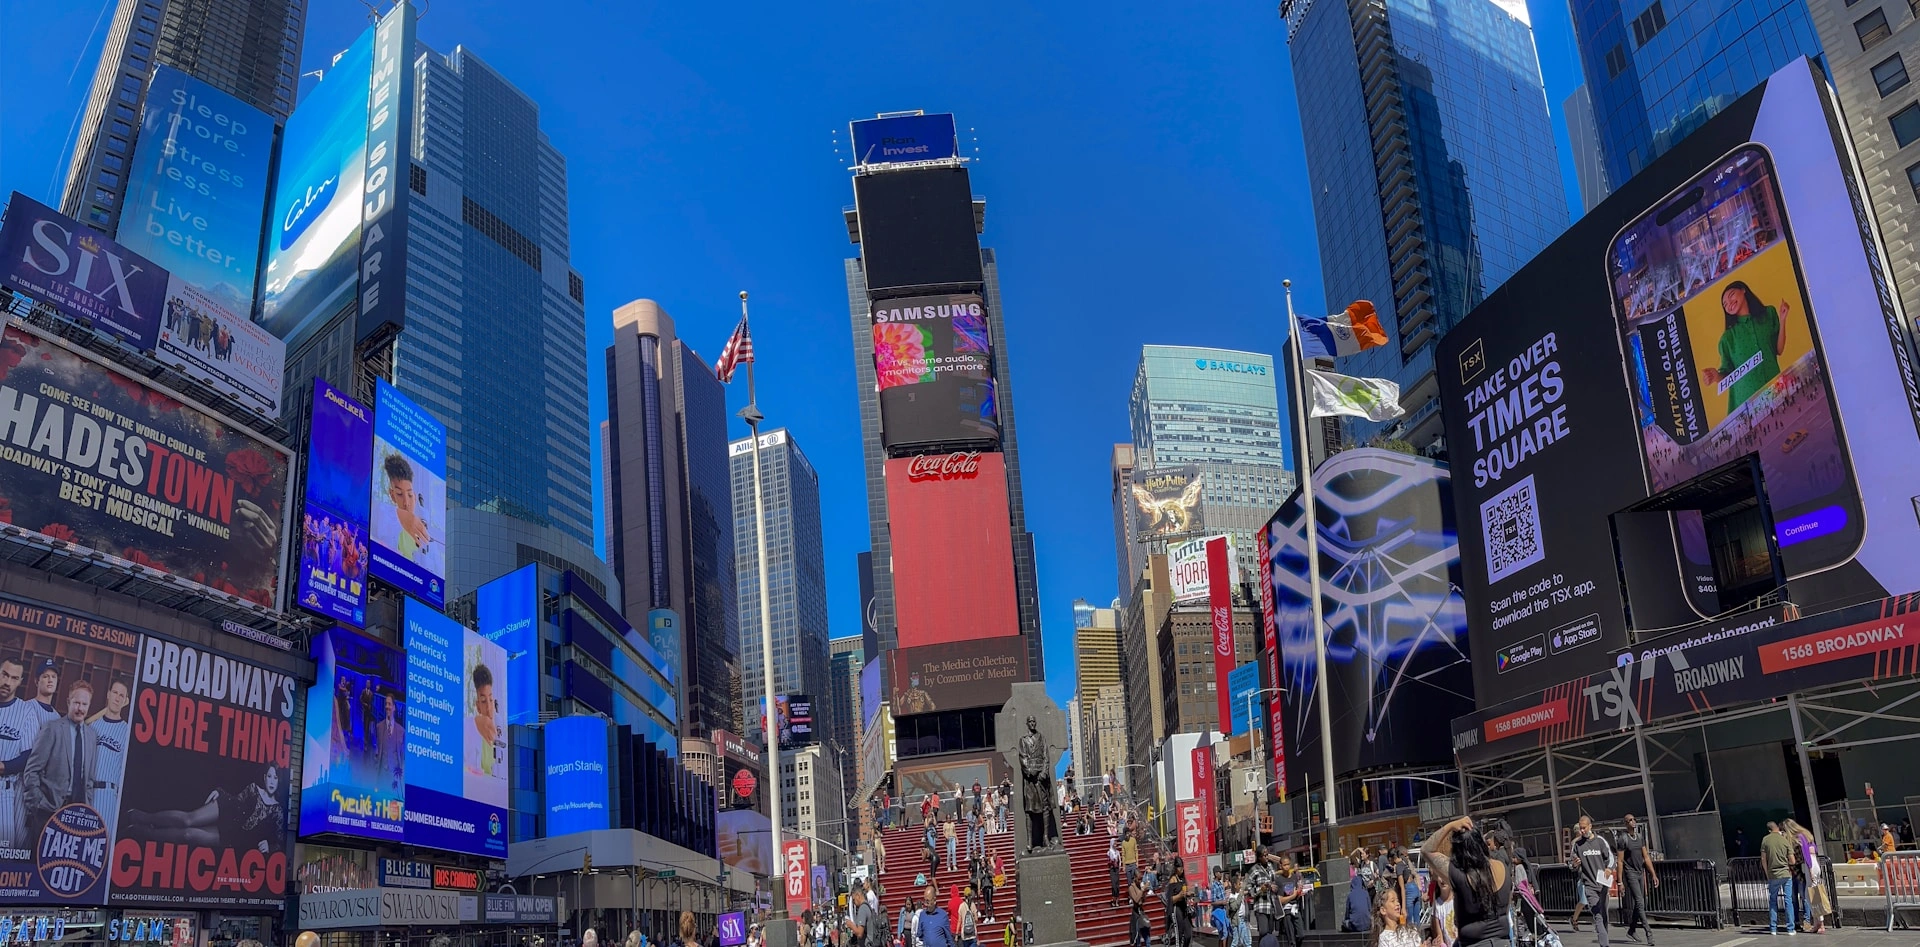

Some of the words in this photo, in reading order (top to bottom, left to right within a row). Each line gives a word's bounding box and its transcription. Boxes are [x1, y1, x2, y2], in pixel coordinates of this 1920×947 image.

[372, 21, 394, 133] TIMES
[171, 88, 247, 135] Sleep
[167, 111, 246, 157] more.
[162, 137, 244, 188] Stress
[883, 144, 929, 155] Invest
[156, 157, 218, 200] less.
[151, 191, 207, 230] Live
[284, 175, 336, 231] Calm
[362, 140, 387, 316] SQUARE
[145, 216, 242, 273] better.
[1865, 238, 1882, 270] BIG
[22, 220, 143, 319] SIX
[51, 280, 68, 296] THE
[73, 291, 115, 319] MUSICAL
[1878, 275, 1896, 308] THE
[876, 303, 981, 323] SAMSUNG
[1889, 311, 1903, 341] ON
[1656, 329, 1667, 350] GO
[1666, 313, 1682, 359] TIMES
[234, 353, 280, 391] WRONG
[885, 366, 931, 376] monitors
[933, 364, 954, 372] and
[956, 362, 986, 371] more.
[912, 355, 943, 365] home
[945, 354, 977, 363] audio,
[1210, 361, 1266, 376] BARCLAYS
[1462, 351, 1481, 372] TSX
[1464, 368, 1507, 413] TAKE
[1509, 332, 1558, 380] OVER
[1661, 351, 1672, 372] TO
[1675, 358, 1691, 399] OVER
[1719, 362, 1750, 393] HAPPY
[381, 387, 393, 398] We
[393, 395, 414, 415] ensure
[414, 407, 441, 436] America's
[1467, 361, 1564, 452] TIMES
[1665, 372, 1686, 437] TSX.LIVE
[39, 383, 70, 405] COME
[71, 394, 90, 413] SEE
[90, 402, 115, 422] HOW
[116, 413, 135, 431] THE
[136, 421, 167, 445] WORLD
[167, 434, 195, 456] COULD
[194, 446, 208, 463] BE.
[381, 398, 409, 420] students
[407, 412, 422, 428] have
[423, 427, 441, 443] access
[390, 411, 398, 421] to
[398, 416, 433, 448] high-quality
[1683, 399, 1700, 442] TAKE
[0, 385, 235, 525] HADESTOWN
[387, 420, 414, 443] summer
[412, 436, 436, 460] learning
[393, 433, 429, 462] experiences
[736, 440, 765, 453] Alliz
[1473, 404, 1570, 488] SQUARE
[108, 484, 131, 502] AND
[59, 481, 104, 511] BEST
[105, 497, 174, 537] MUSICAL
[1504, 524, 1517, 536] TSX
[1784, 520, 1819, 537] Continue
[1175, 541, 1205, 562] LITTLE
[1176, 561, 1208, 593] HORR
[1696, 574, 1714, 582] Video
[1262, 562, 1275, 640] CHOCOLATE
[1490, 599, 1512, 614] Scan
[1512, 590, 1527, 606] the
[1528, 578, 1551, 597] code
[1552, 573, 1564, 586] to
[1492, 603, 1533, 631] download
[1533, 596, 1549, 612] the
[1550, 586, 1572, 606] TSX
[1574, 579, 1596, 597] app.
[22, 606, 44, 624] HIT
[45, 612, 61, 628] OF
[66, 617, 86, 636] THE
[90, 623, 136, 648] SEASON!
[409, 620, 423, 634] We
[424, 628, 449, 648] ensure
[506, 618, 531, 634] Stanley
[1563, 633, 1578, 646] App
[1579, 626, 1598, 639] Store
[409, 637, 447, 662] America's
[1510, 650, 1530, 664] Google
[1530, 645, 1543, 659] Play
[1782, 643, 1813, 662] 1568
[1816, 623, 1906, 656] BROADWAY
[142, 637, 295, 717] BROADWAY'S
[409, 655, 442, 679] students
[443, 669, 461, 684] have
[923, 662, 940, 673] The
[942, 659, 971, 671] Medici
[972, 654, 1018, 667] Collection,
[924, 675, 935, 688] by
[936, 673, 971, 684] Cozomo
[973, 671, 986, 680] de'
[987, 667, 1017, 679] Medici
[1673, 655, 1744, 694] BROADWAY
[408, 672, 433, 689] access
[435, 681, 444, 693] to
[1583, 664, 1644, 727] TSX
[408, 685, 455, 716] high-quality
[135, 688, 212, 753] SURE
[218, 706, 291, 769] THING
[407, 707, 441, 725] summer
[1495, 721, 1511, 733] 1568
[1511, 707, 1555, 728] BROADWAY
[407, 721, 441, 745] learning
[1273, 711, 1284, 758] COME
[407, 742, 454, 765] experiences
[548, 761, 574, 776] Morgan
[574, 761, 603, 774] Stanley
[61, 814, 76, 824] BEST
[76, 817, 99, 829] REVIVAL
[382, 798, 404, 821] HOT
[404, 810, 475, 834] SUMMERLEARNING.ORG
[1183, 804, 1200, 854] tkts
[41, 827, 82, 859] TAKE
[82, 837, 107, 869] ME
[0, 871, 32, 887] ONLY
[50, 866, 84, 892] OUT
[110, 838, 287, 895] CHICAGO
[217, 876, 228, 884] THE
[385, 859, 412, 876] BLUE
[415, 863, 430, 879] FIN
[436, 870, 449, 887] DOS
[788, 844, 805, 897] tkts
[111, 892, 185, 903] CHICAGOTHEMUSICAL.COM
[300, 896, 379, 921] SWAROVSKI
[382, 892, 459, 920] SWAROVSKI
[487, 899, 504, 911] BLUE
[504, 900, 514, 911] FIN
[517, 897, 534, 912] NOW
[535, 898, 553, 912] OPEN
[110, 918, 165, 942] SLAM
[721, 917, 741, 938] SIX
